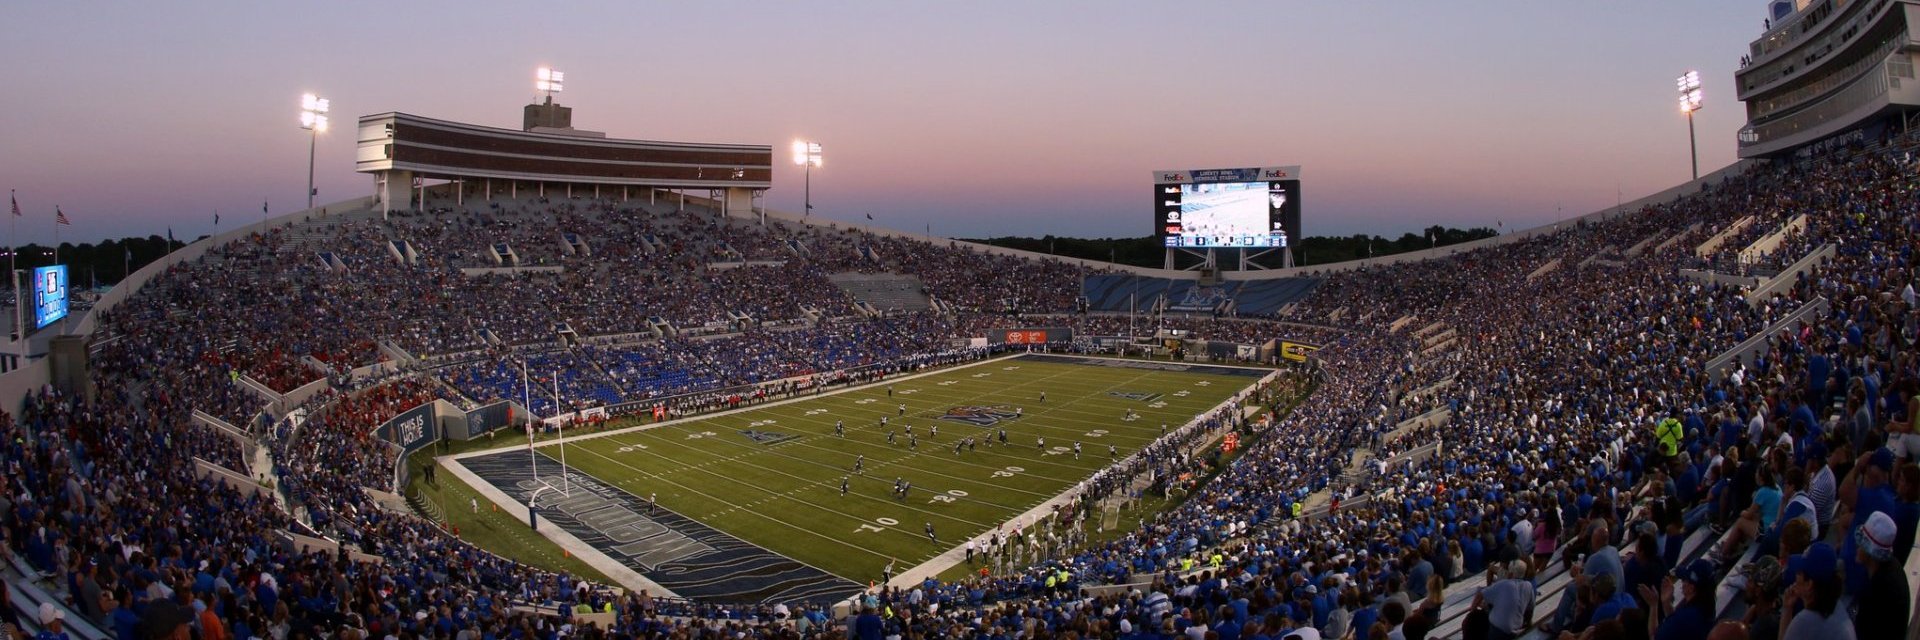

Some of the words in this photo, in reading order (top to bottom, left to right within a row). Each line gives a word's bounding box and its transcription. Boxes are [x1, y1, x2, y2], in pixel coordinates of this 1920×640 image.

[1164, 174, 1184, 182] FedEx
[1265, 170, 1287, 178] FedEx
[400, 418, 416, 436] THIS
[415, 414, 424, 428] IS
[993, 466, 1025, 477] 30
[933, 489, 969, 503] 20
[860, 517, 899, 533] 10
